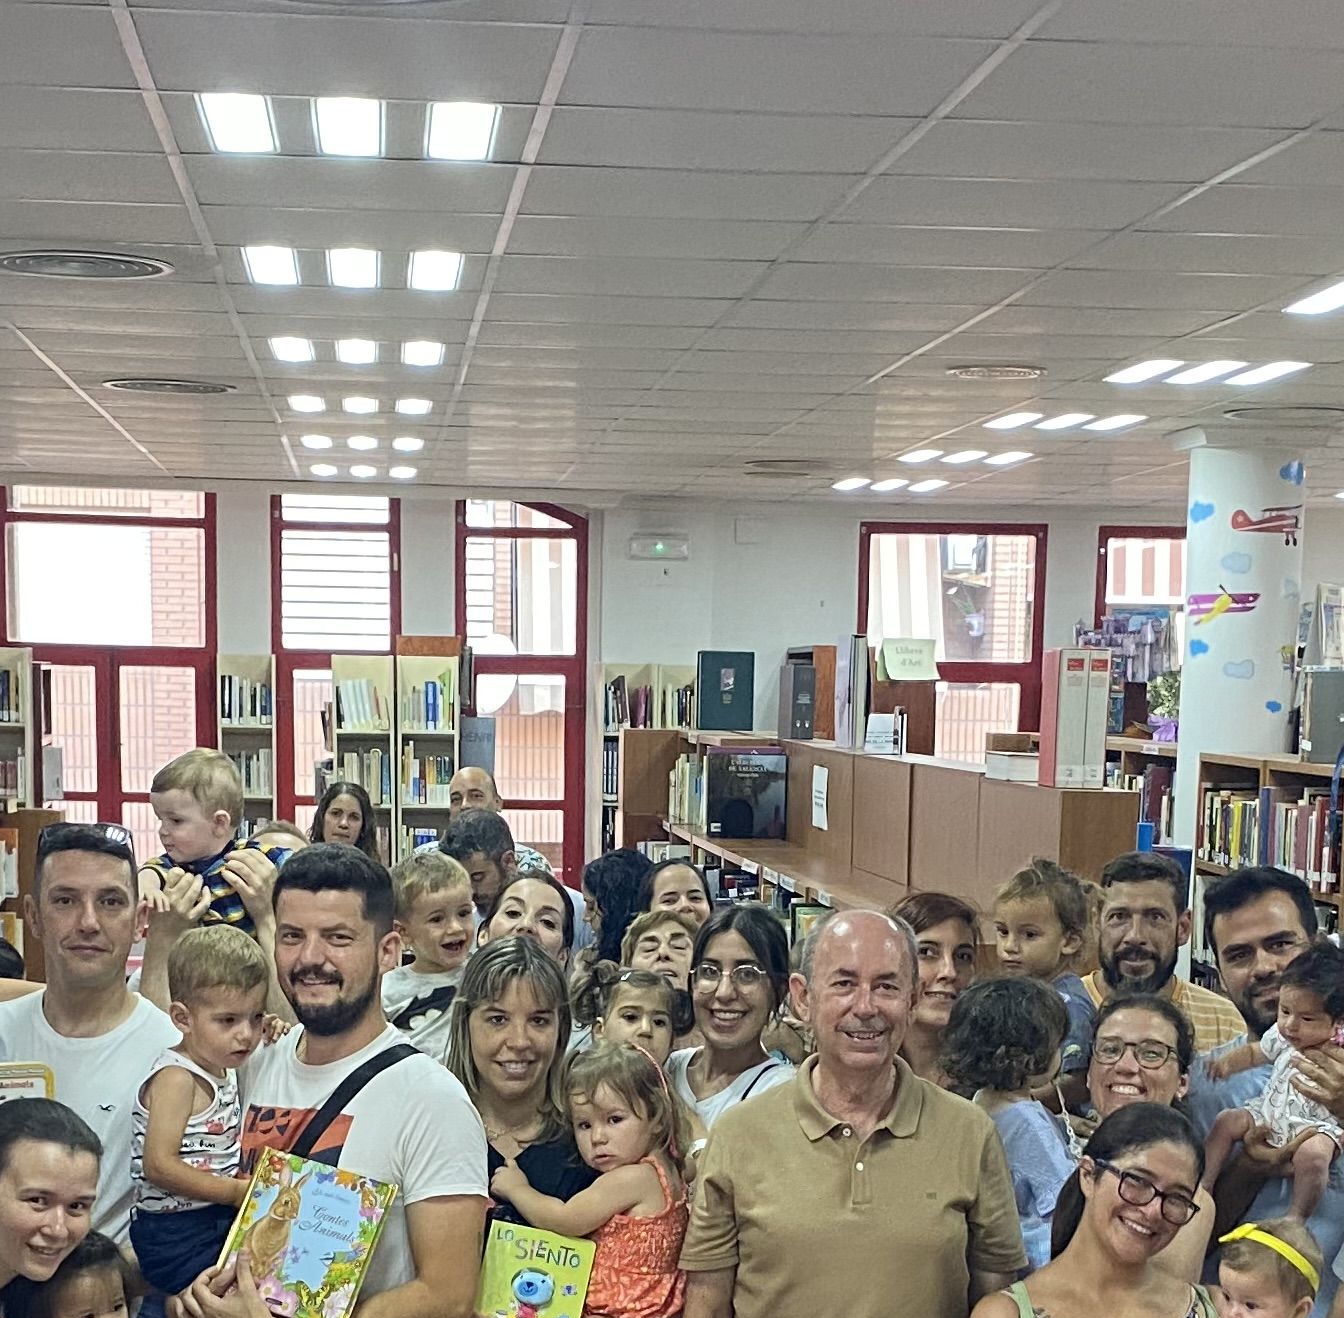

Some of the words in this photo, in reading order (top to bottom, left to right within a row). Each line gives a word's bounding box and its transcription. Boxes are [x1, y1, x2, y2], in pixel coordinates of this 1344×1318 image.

[312, 1204, 350, 1228] Contes
[299, 1220, 356, 1243] Animals
[497, 1228, 514, 1241] LO
[515, 1239, 581, 1268] SIENTO
